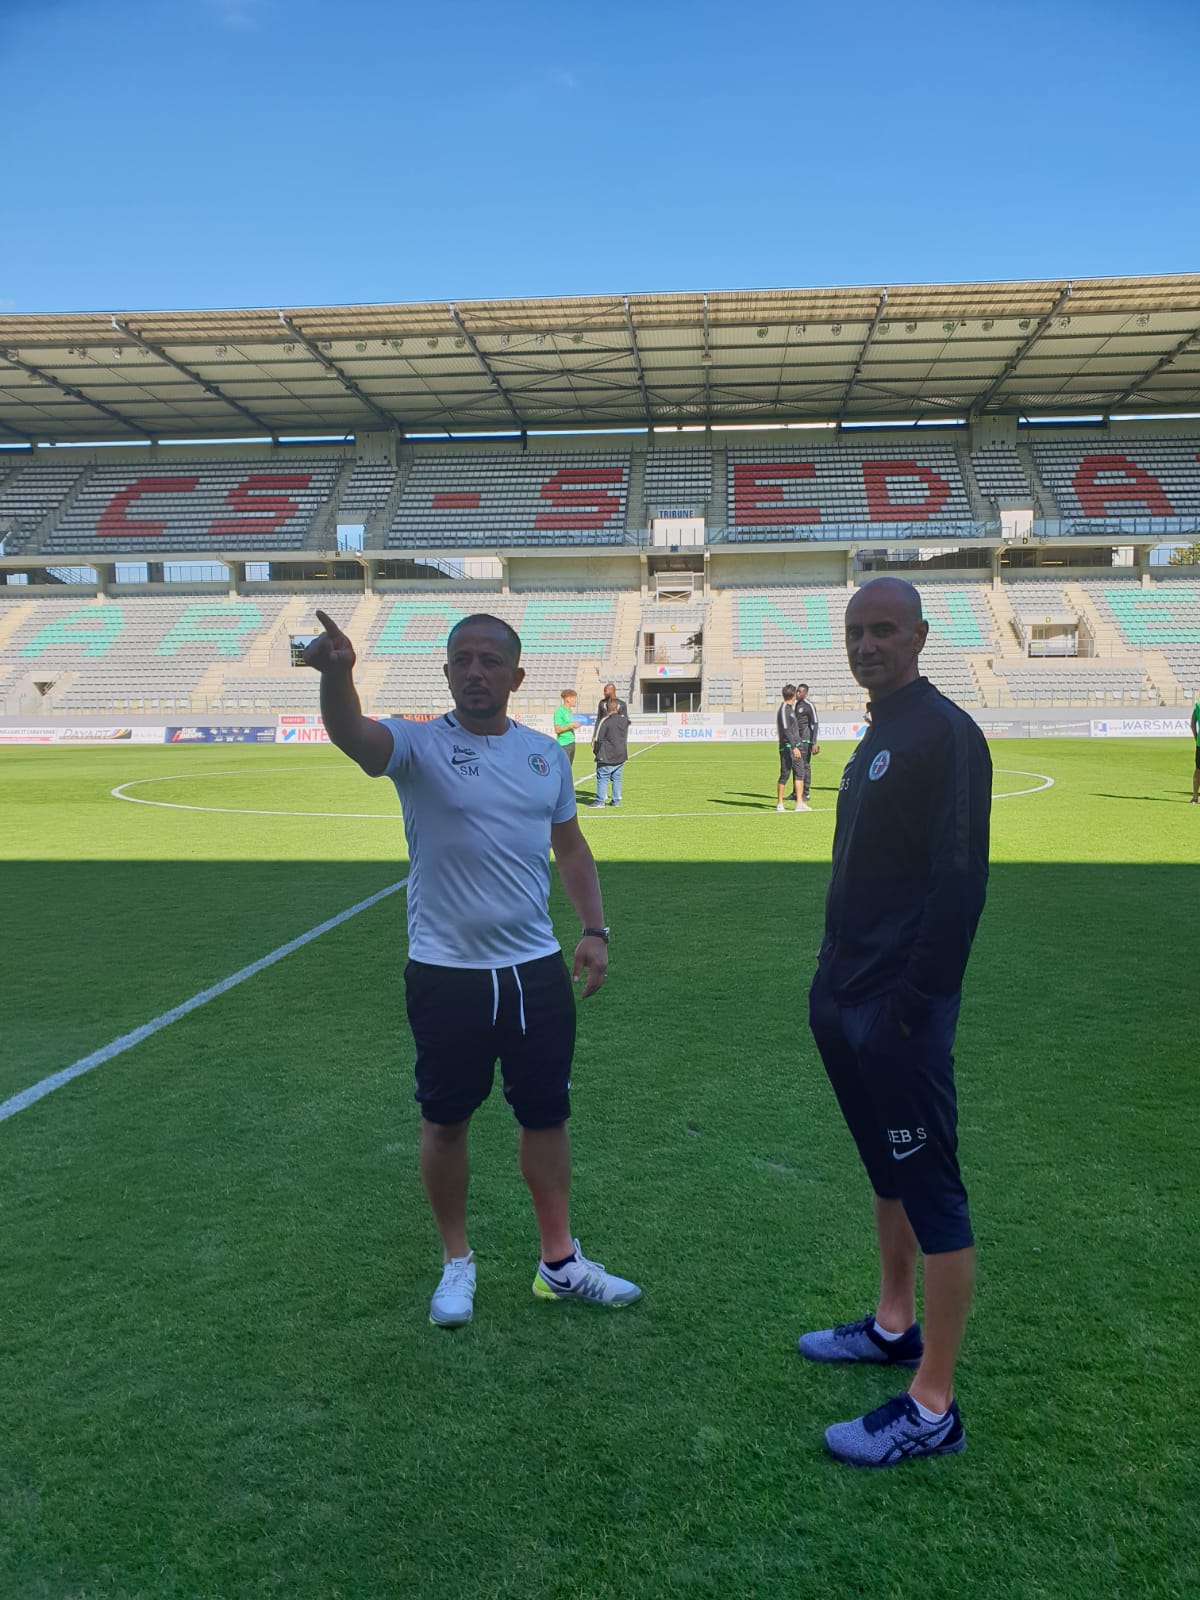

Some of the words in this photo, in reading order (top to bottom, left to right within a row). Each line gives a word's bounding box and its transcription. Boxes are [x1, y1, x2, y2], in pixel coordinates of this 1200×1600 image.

[659, 510, 694, 519] TRIBUNE
[298, 729, 328, 742] INTE
[678, 728, 712, 738] SEDAN
[732, 727, 777, 737] ALTEREG
[460, 765, 480, 777] SM
